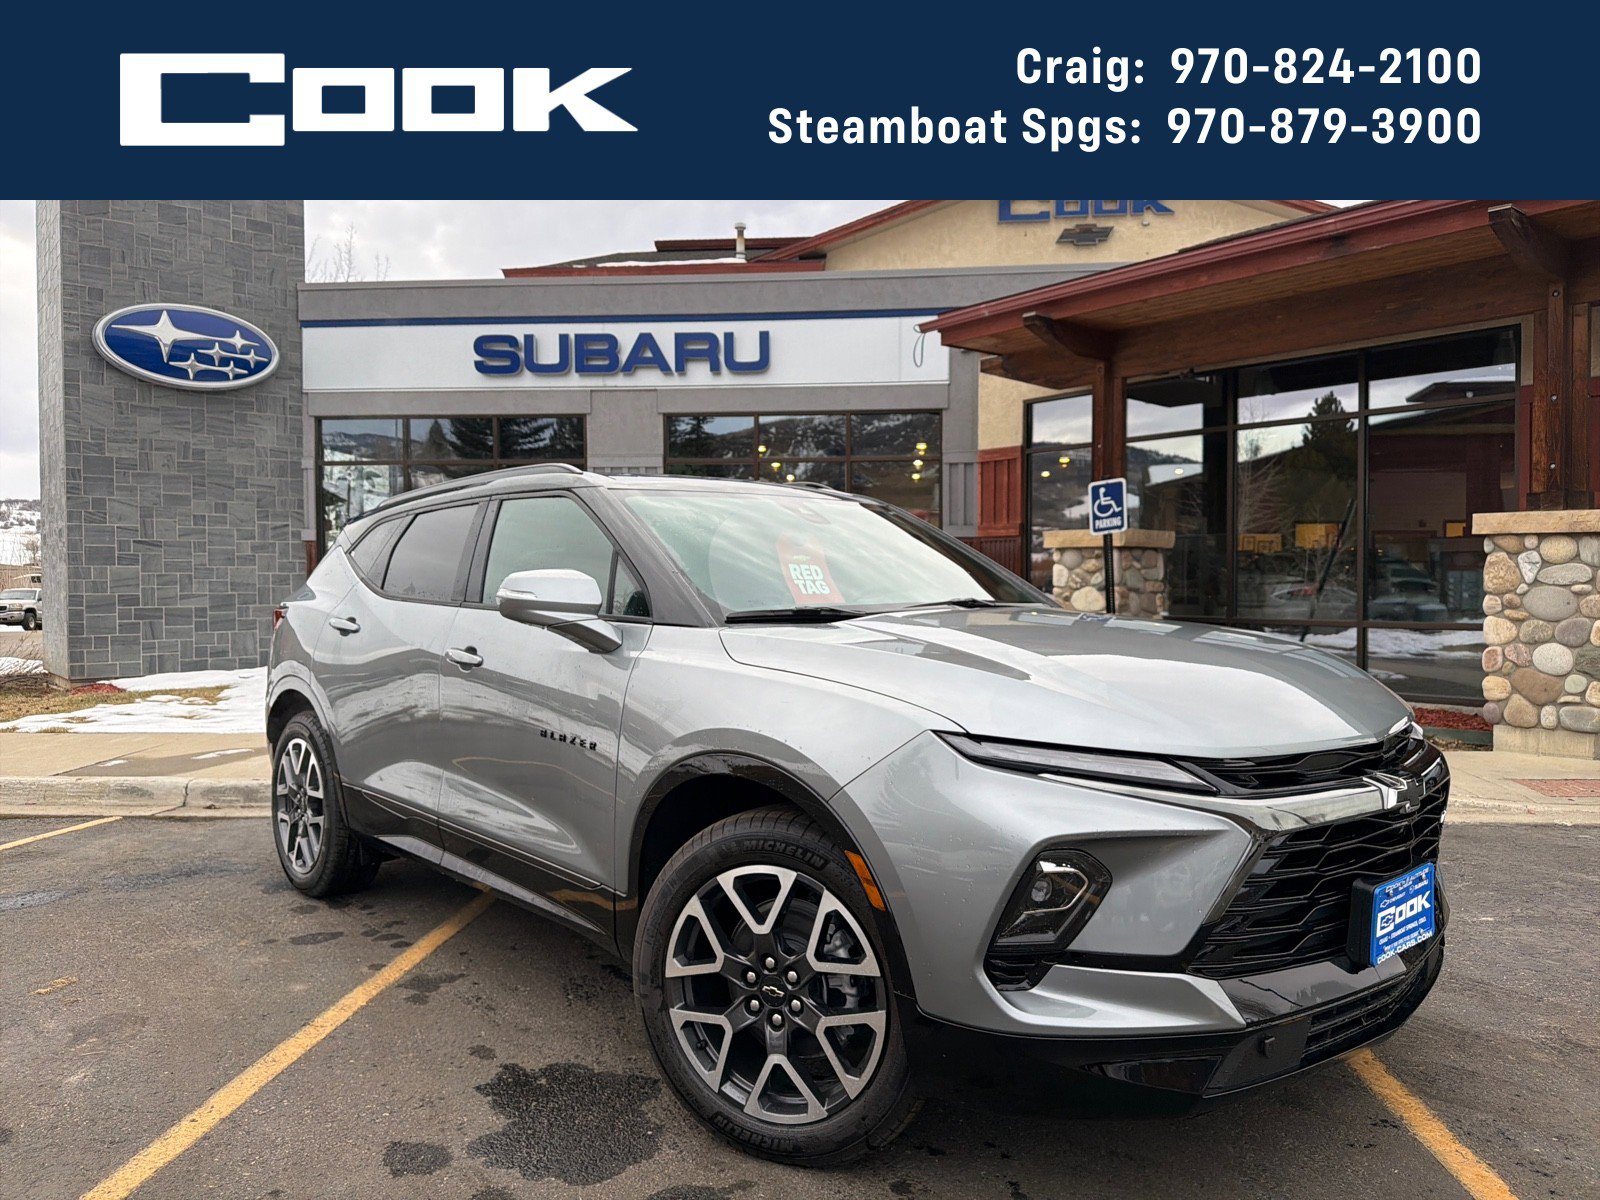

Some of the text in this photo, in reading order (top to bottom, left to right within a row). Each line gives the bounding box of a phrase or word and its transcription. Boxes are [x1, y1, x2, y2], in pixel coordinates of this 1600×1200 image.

[473, 331, 771, 376] SUBARU
[1095, 516, 1122, 529] PARKING
[789, 563, 824, 580] RED
[793, 579, 831, 595] TAG
[540, 729, 597, 751] BLAZER
[742, 838, 828, 870] MICHELIN
[1376, 890, 1431, 938] COOK
[1377, 930, 1433, 964] COOK-CARS.COM
